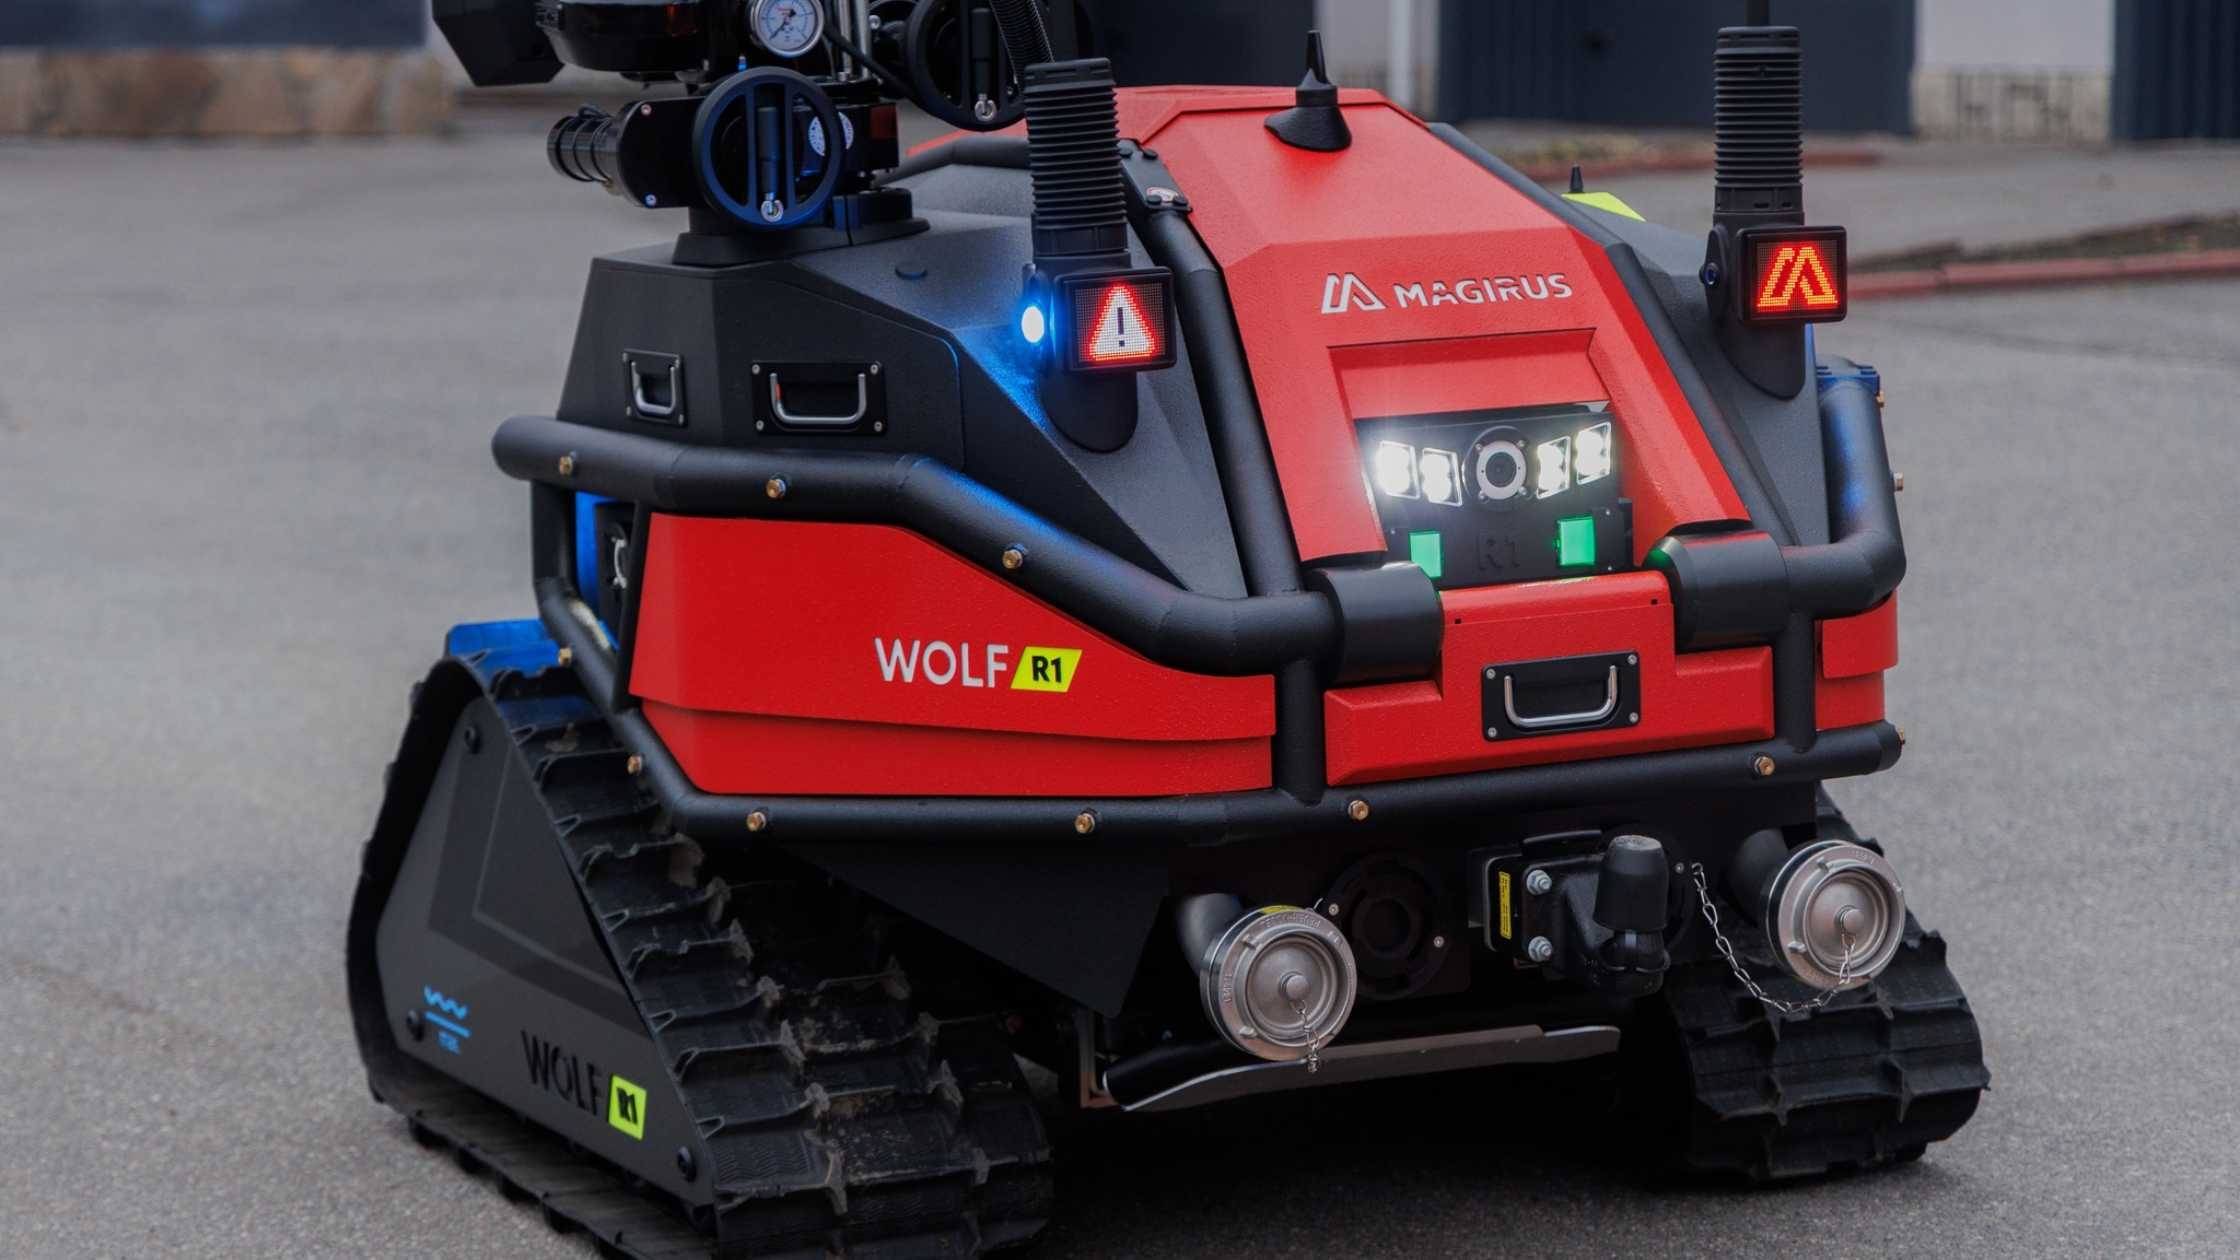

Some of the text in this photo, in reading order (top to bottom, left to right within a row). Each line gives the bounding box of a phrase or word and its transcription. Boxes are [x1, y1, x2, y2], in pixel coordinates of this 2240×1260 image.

[1393, 274, 1574, 308] MAGIRUS
[874, 637, 1062, 688] WOLF R1
[520, 1029, 638, 1126] WOLF R1
